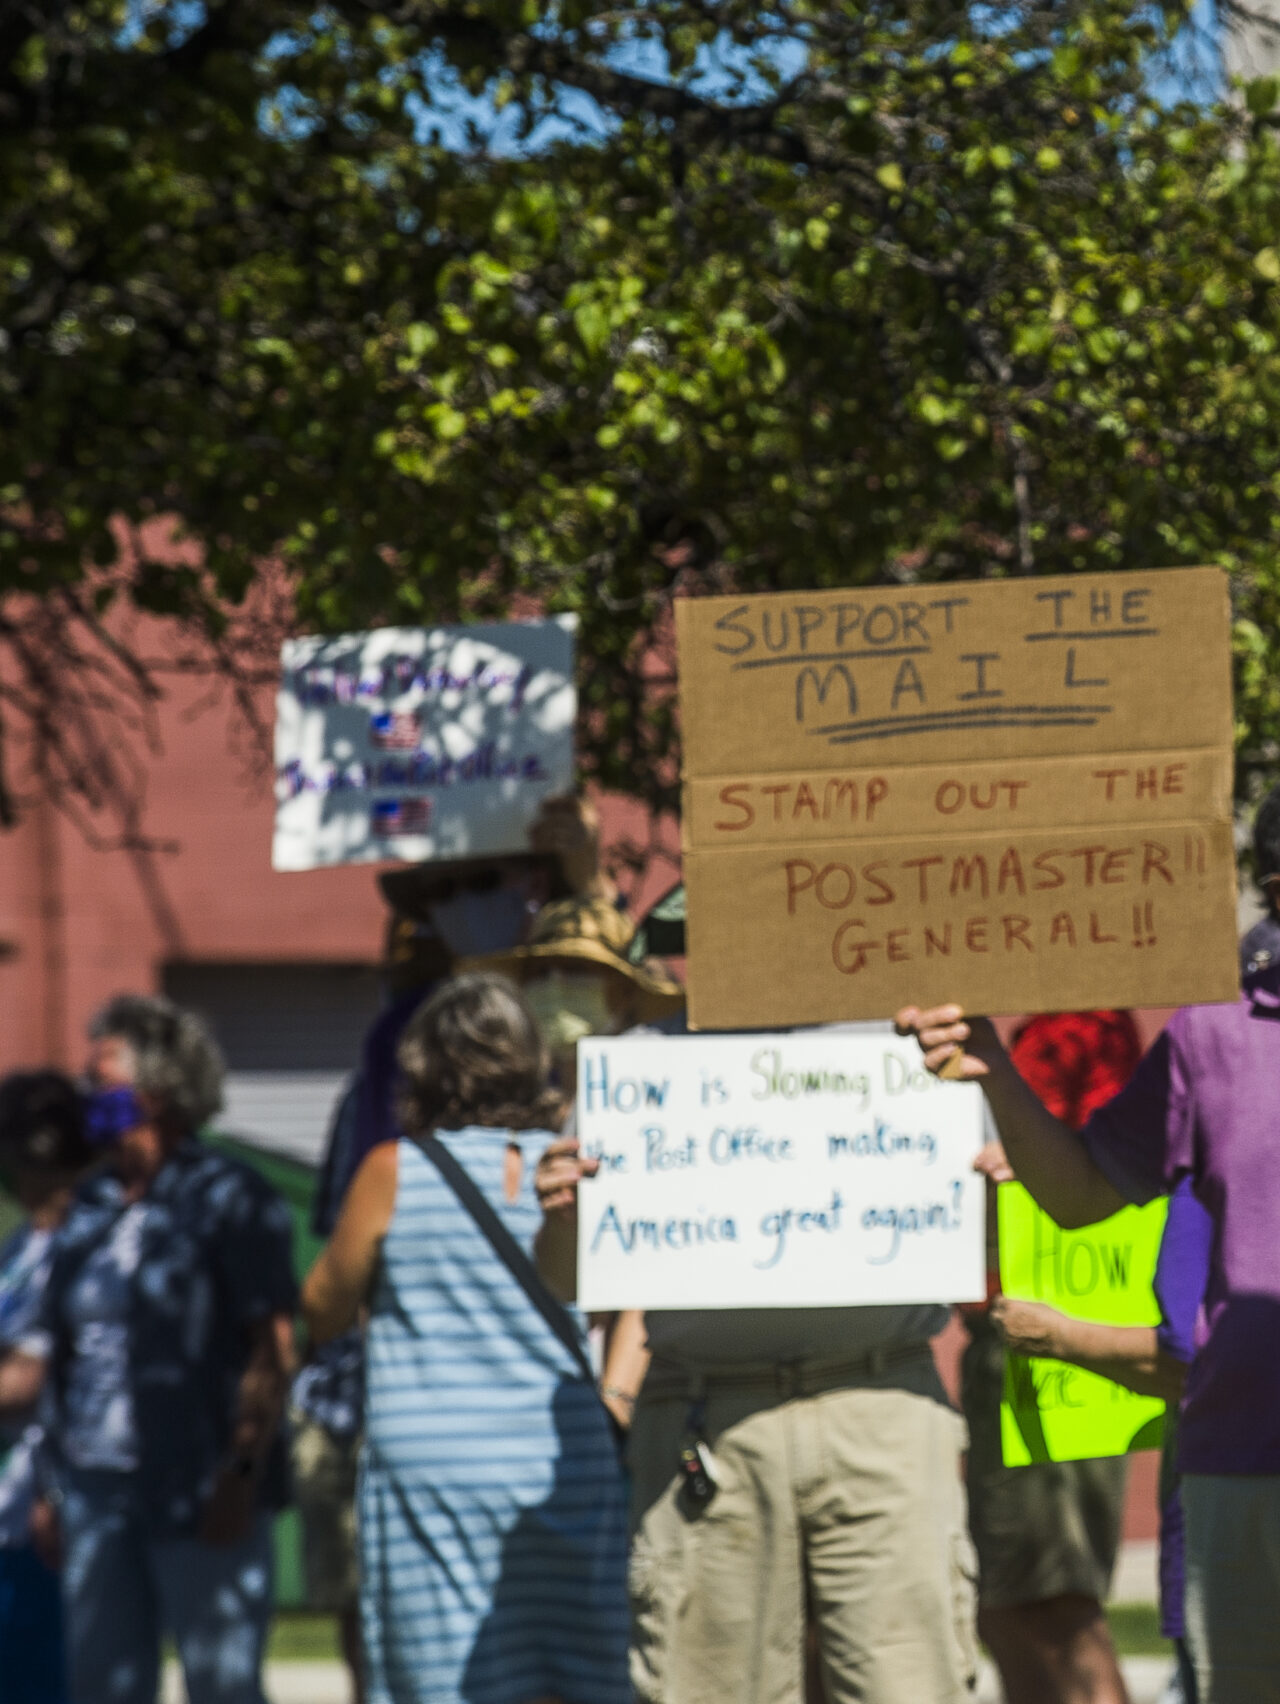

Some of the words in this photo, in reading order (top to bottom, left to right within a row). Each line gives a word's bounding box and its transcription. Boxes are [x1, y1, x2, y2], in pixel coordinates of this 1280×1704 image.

[712, 598, 972, 656] SUPPORT
[1036, 588, 1153, 630] THE
[795, 646, 1110, 722] MAIL
[713, 776, 890, 832] STAMP
[934, 779, 1031, 816] OUT
[1093, 762, 1189, 802] THE
[830, 900, 1157, 976] GENERAL!!
[583, 1051, 668, 1114] How
[698, 1072, 730, 1106] is
[750, 1048, 872, 1112] Slowing
[642, 1126, 698, 1173] Post
[827, 1114, 938, 1165] making
[589, 1204, 738, 1254] America
[753, 1188, 846, 1270] great
[1032, 1220, 1134, 1300] HOW
